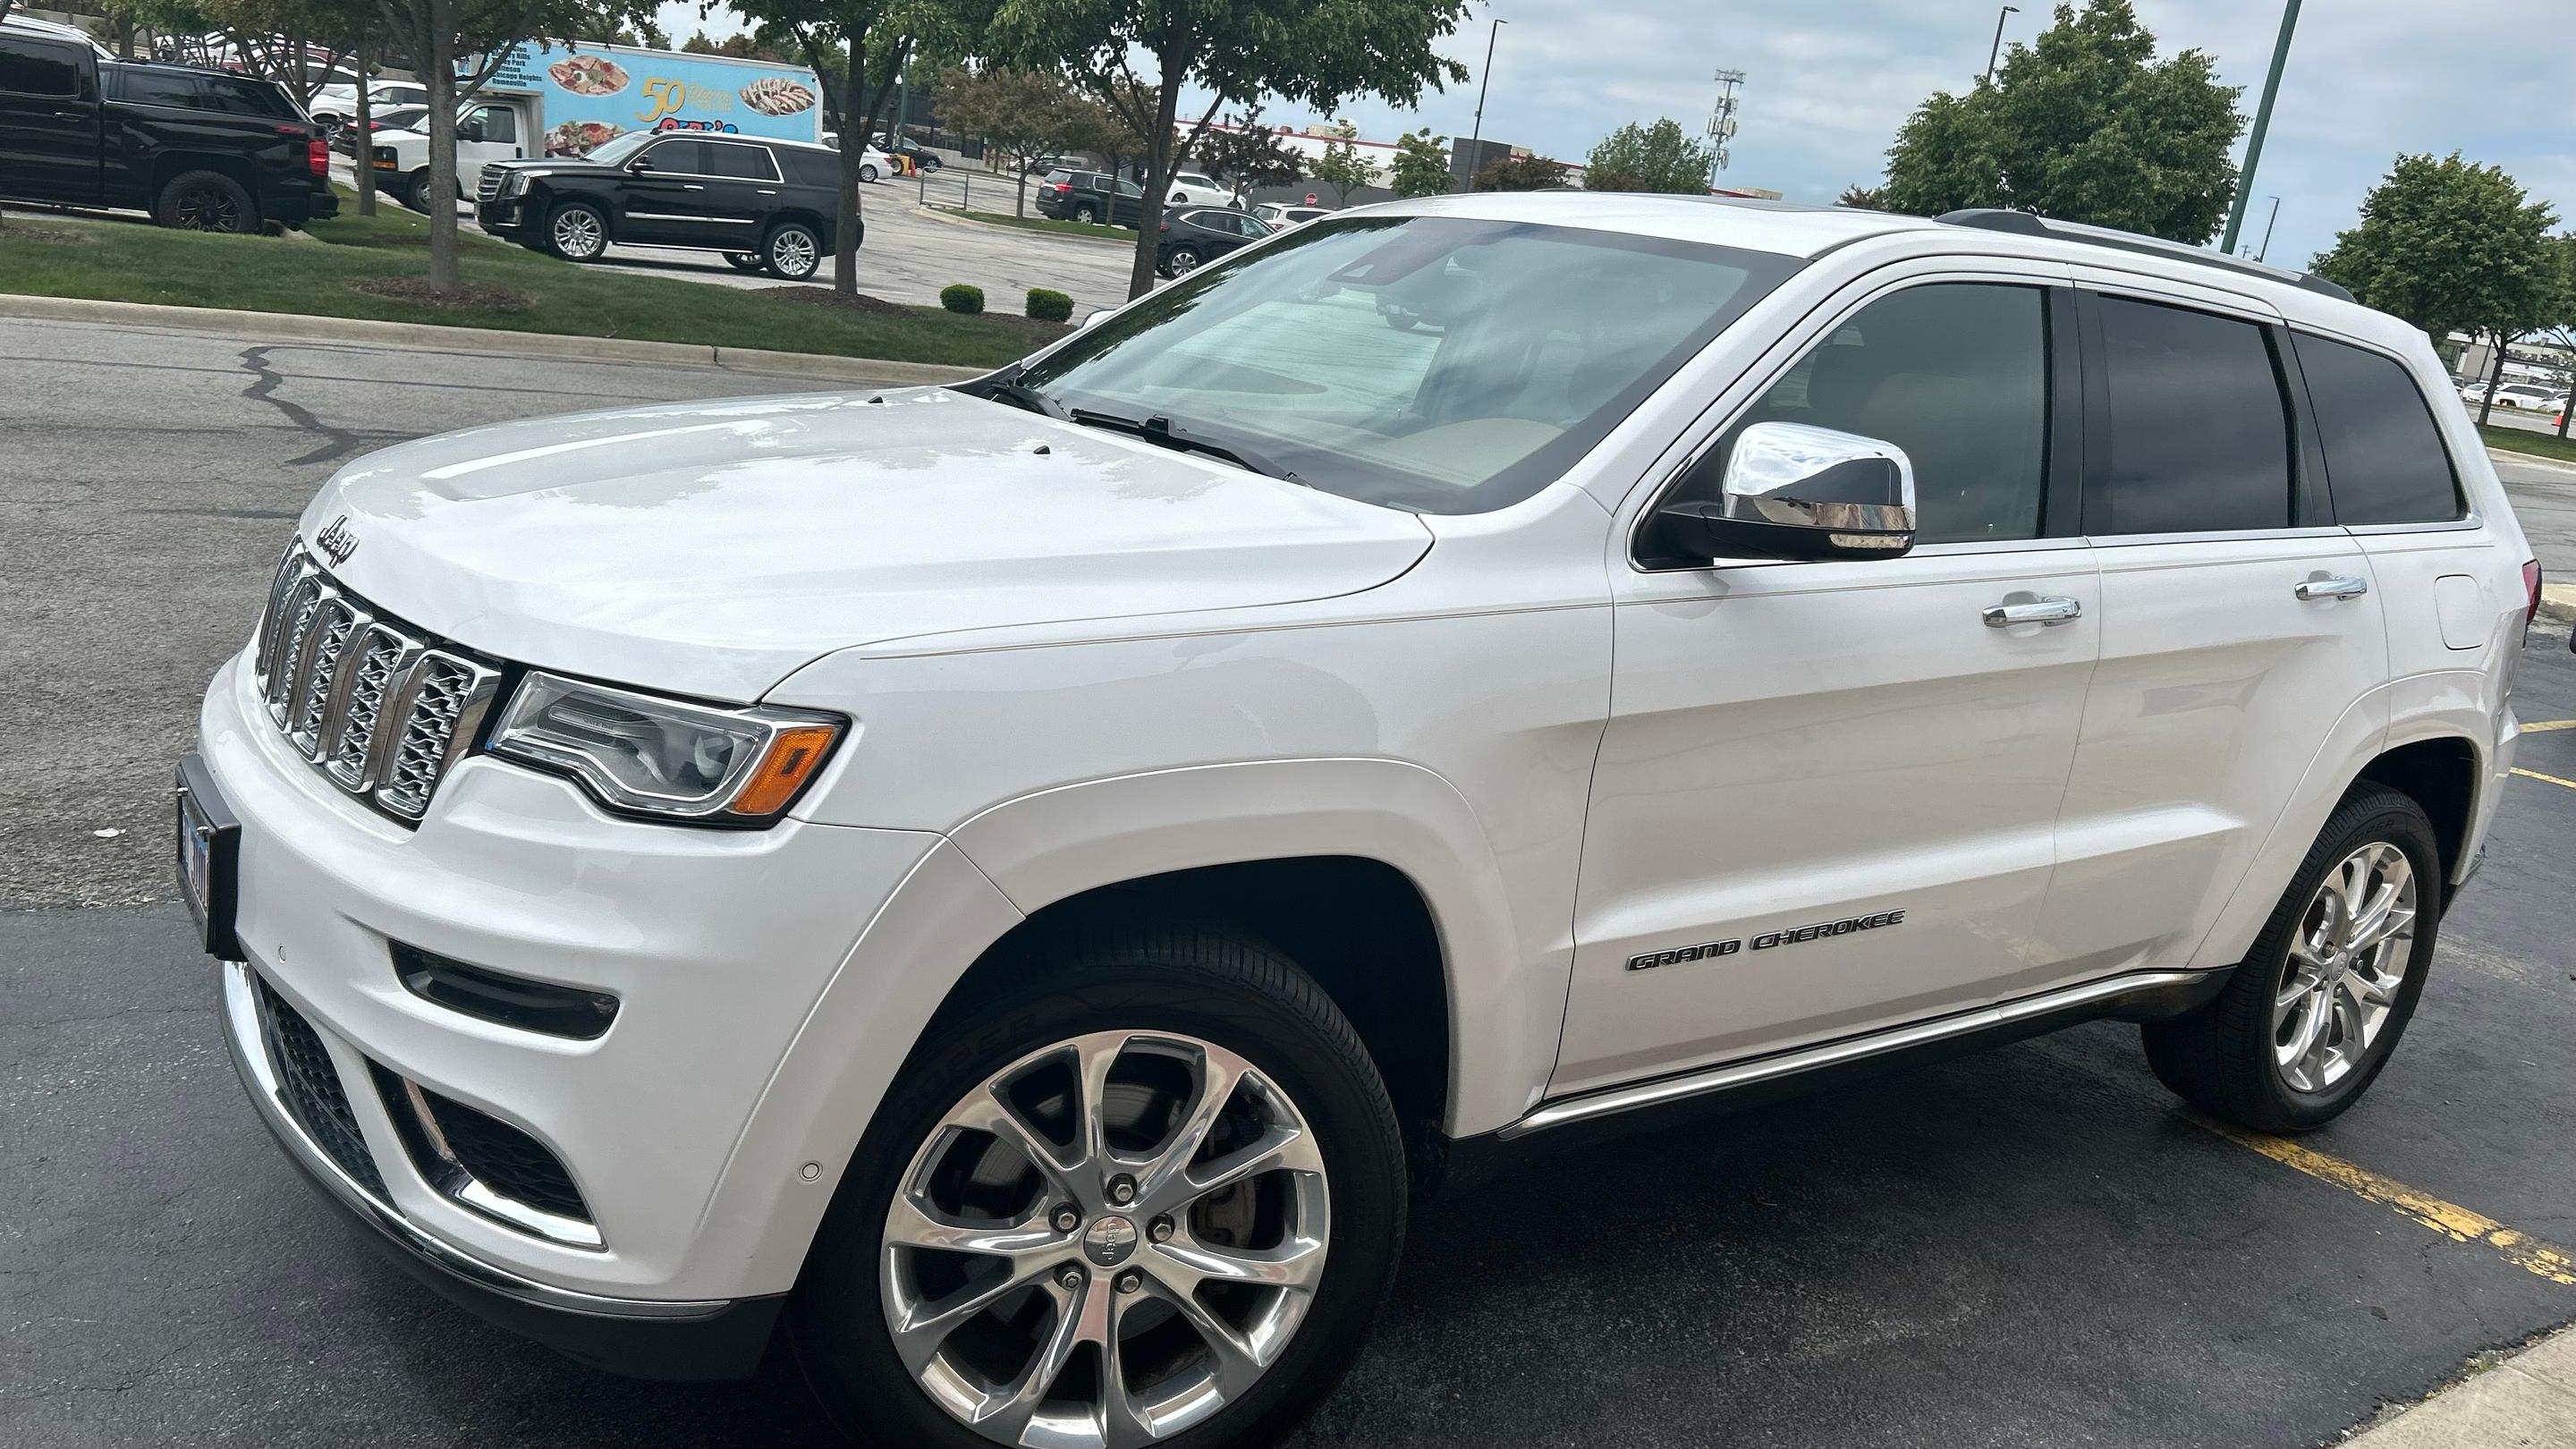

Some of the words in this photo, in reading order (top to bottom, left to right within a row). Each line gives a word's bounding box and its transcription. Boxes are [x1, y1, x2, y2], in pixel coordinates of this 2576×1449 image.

[495, 72, 517, 80] hicago
[634, 77, 686, 123] 50
[317, 514, 360, 569] Jeep
[1624, 937, 1742, 971] GRAND
[1749, 908, 1906, 950] CHEROKEE
